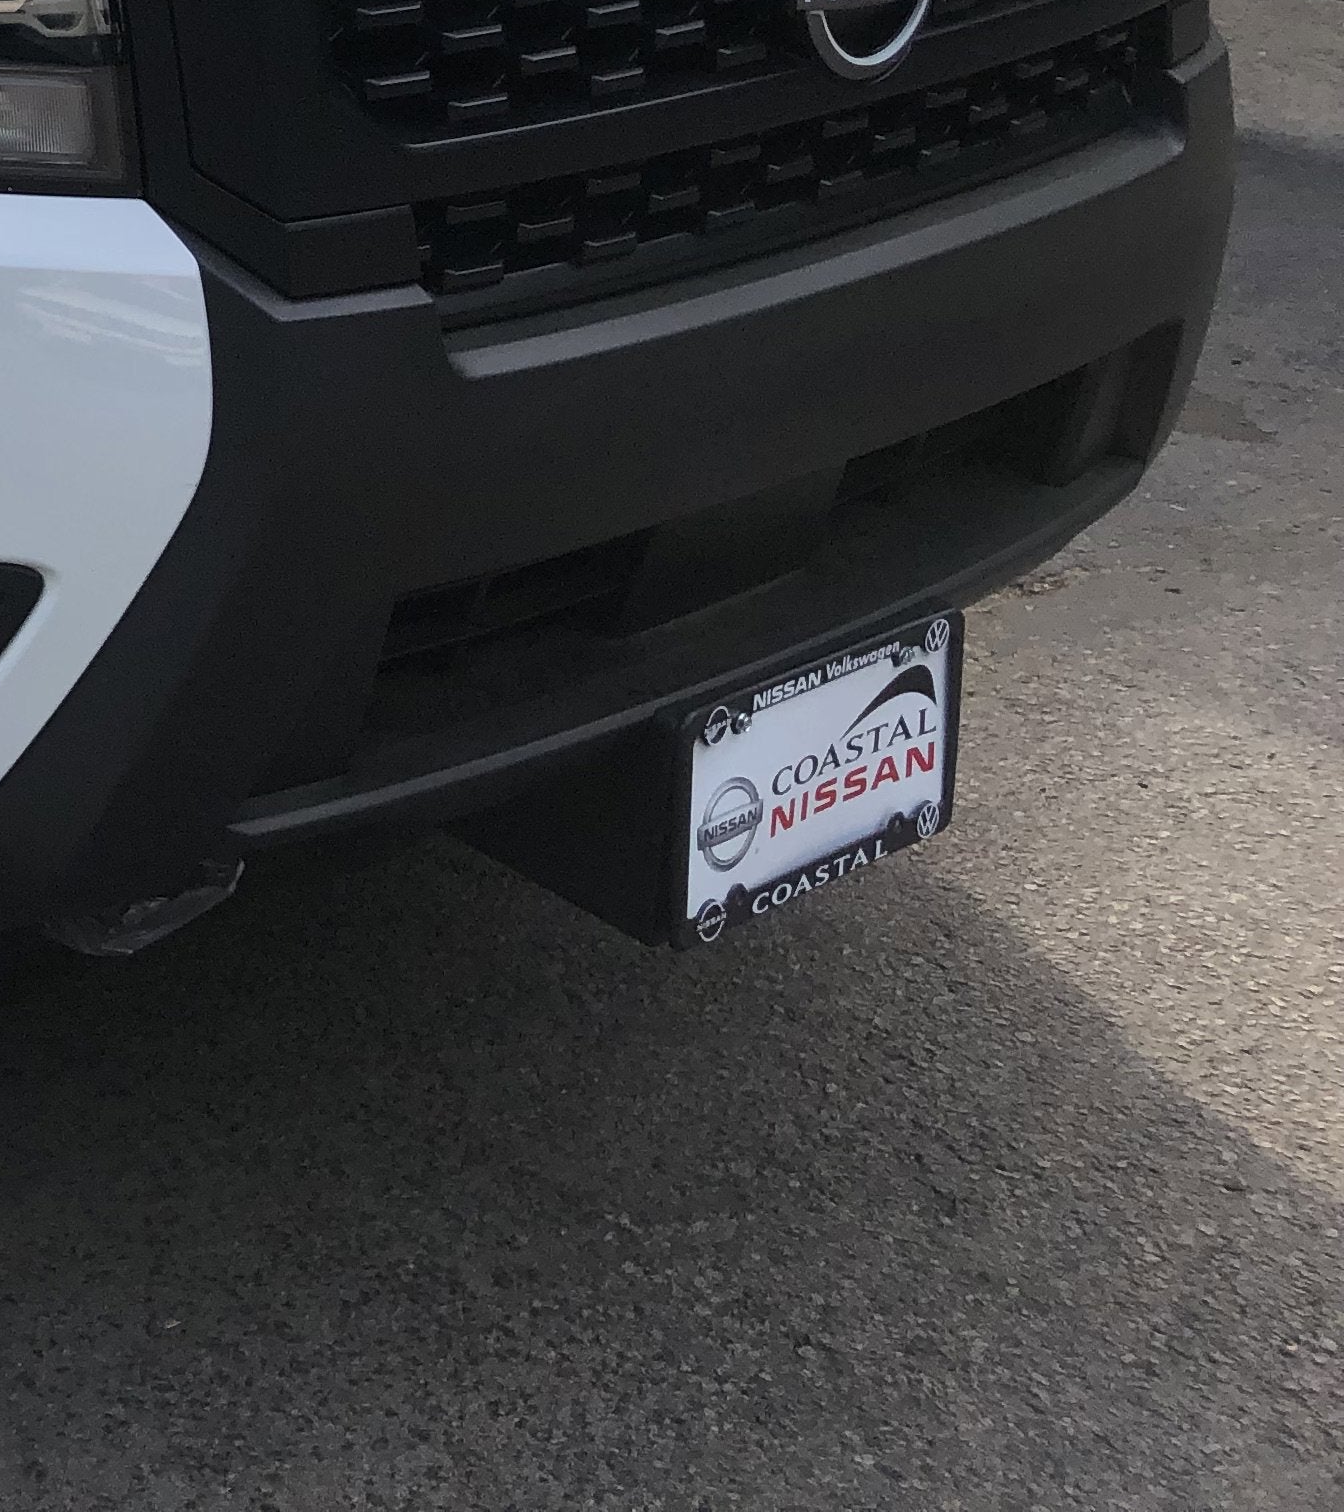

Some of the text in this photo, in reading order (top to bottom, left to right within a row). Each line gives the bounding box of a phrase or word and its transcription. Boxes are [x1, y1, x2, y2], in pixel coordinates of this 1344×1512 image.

[753, 641, 901, 710] NISSAN Volkswagen
[772, 707, 937, 796] COASTAL
[703, 807, 759, 842] NISSAN
[770, 741, 936, 838] NISSAN
[752, 839, 889, 914] COASTAL
